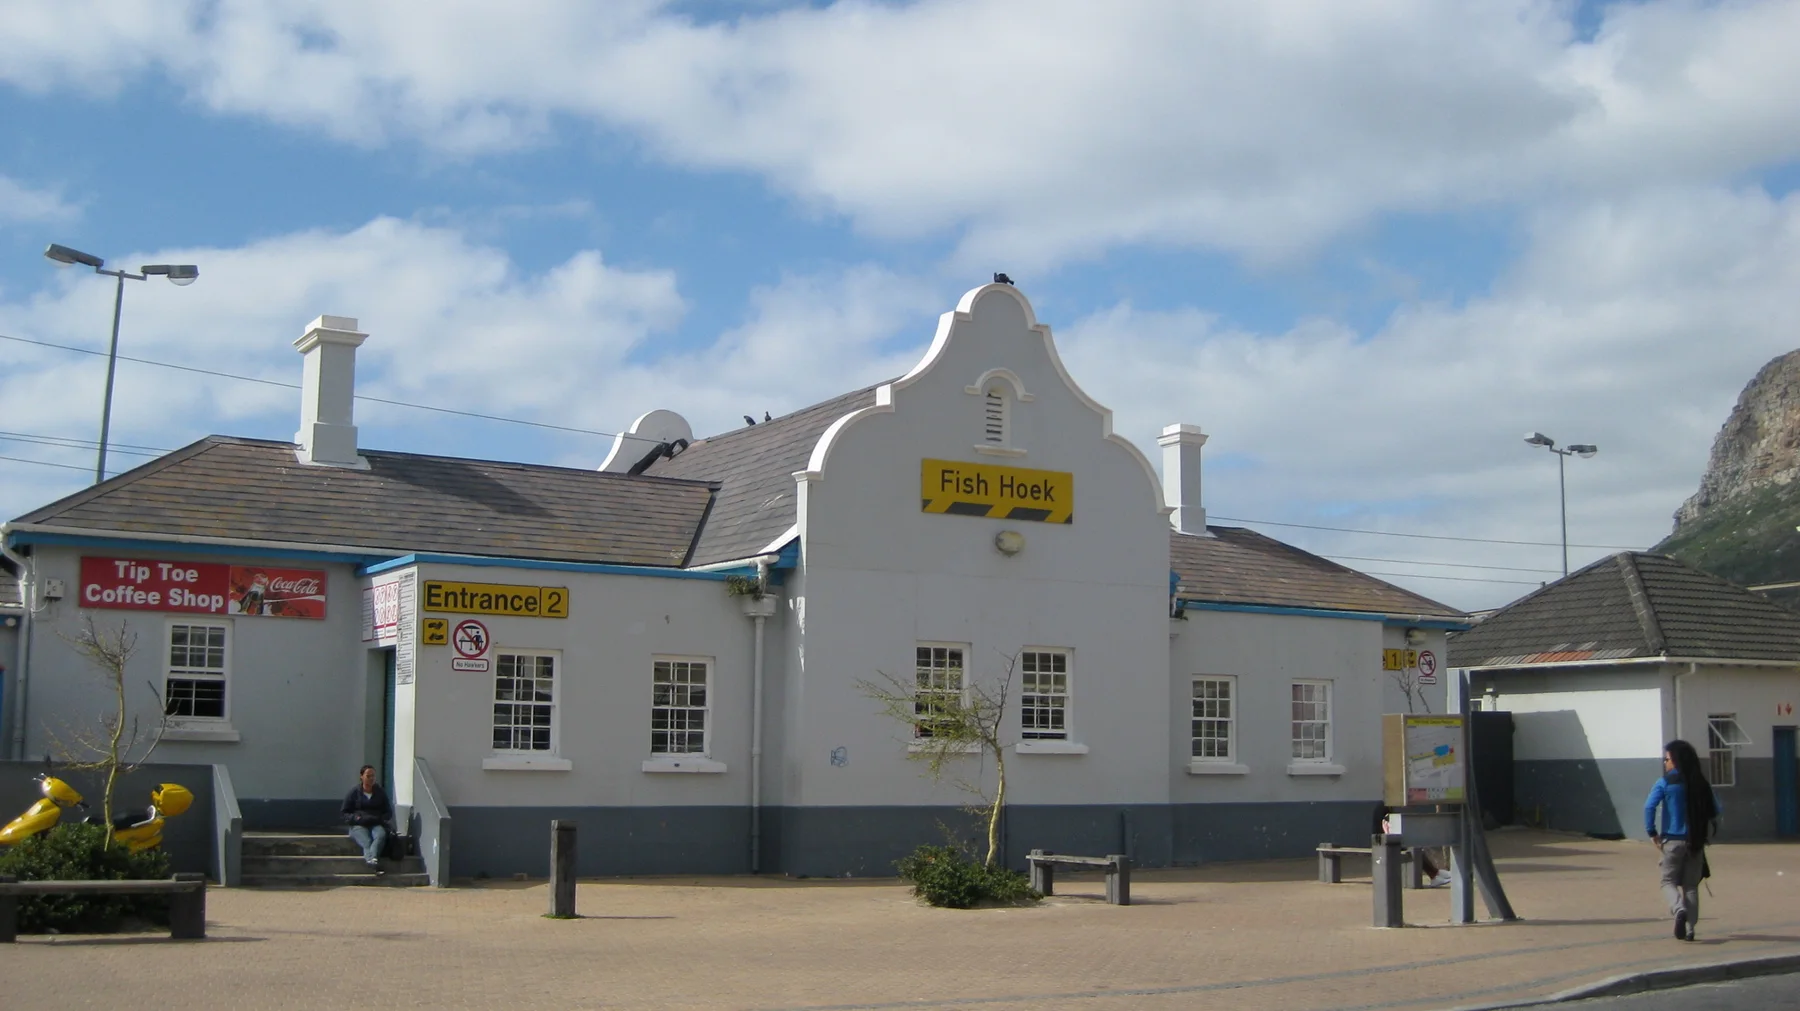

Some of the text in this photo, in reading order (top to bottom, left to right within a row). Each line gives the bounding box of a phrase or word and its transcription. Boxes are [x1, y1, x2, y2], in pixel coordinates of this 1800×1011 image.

[941, 469, 1055, 502] Fish Hoek
[115, 560, 199, 583] Tip Toe
[86, 584, 224, 612] Coffee Shop
[427, 584, 562, 613] Entrance 2
[1392, 652, 1397, 667] 1
